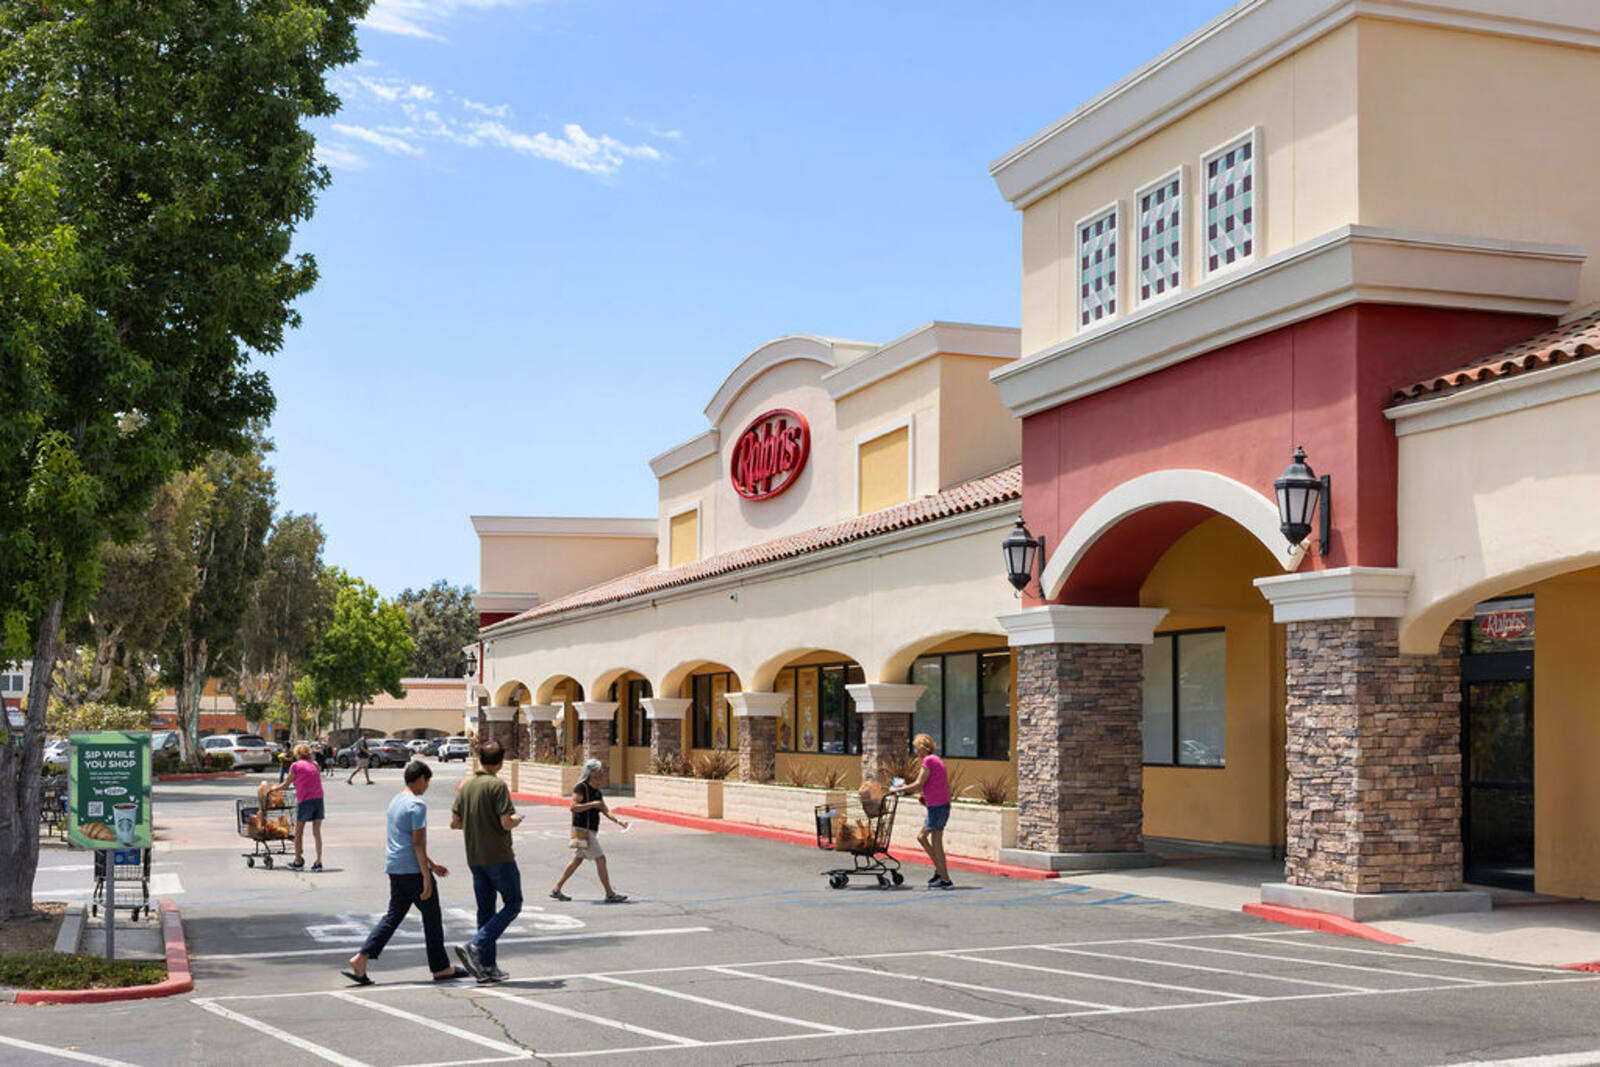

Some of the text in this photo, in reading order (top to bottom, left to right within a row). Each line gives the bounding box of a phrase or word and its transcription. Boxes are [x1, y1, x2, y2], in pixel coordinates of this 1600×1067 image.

[739, 418, 802, 495] Ralphs
[84, 750, 136, 759] SIP WHILE
[84, 760, 137, 769] YOU SHOP
